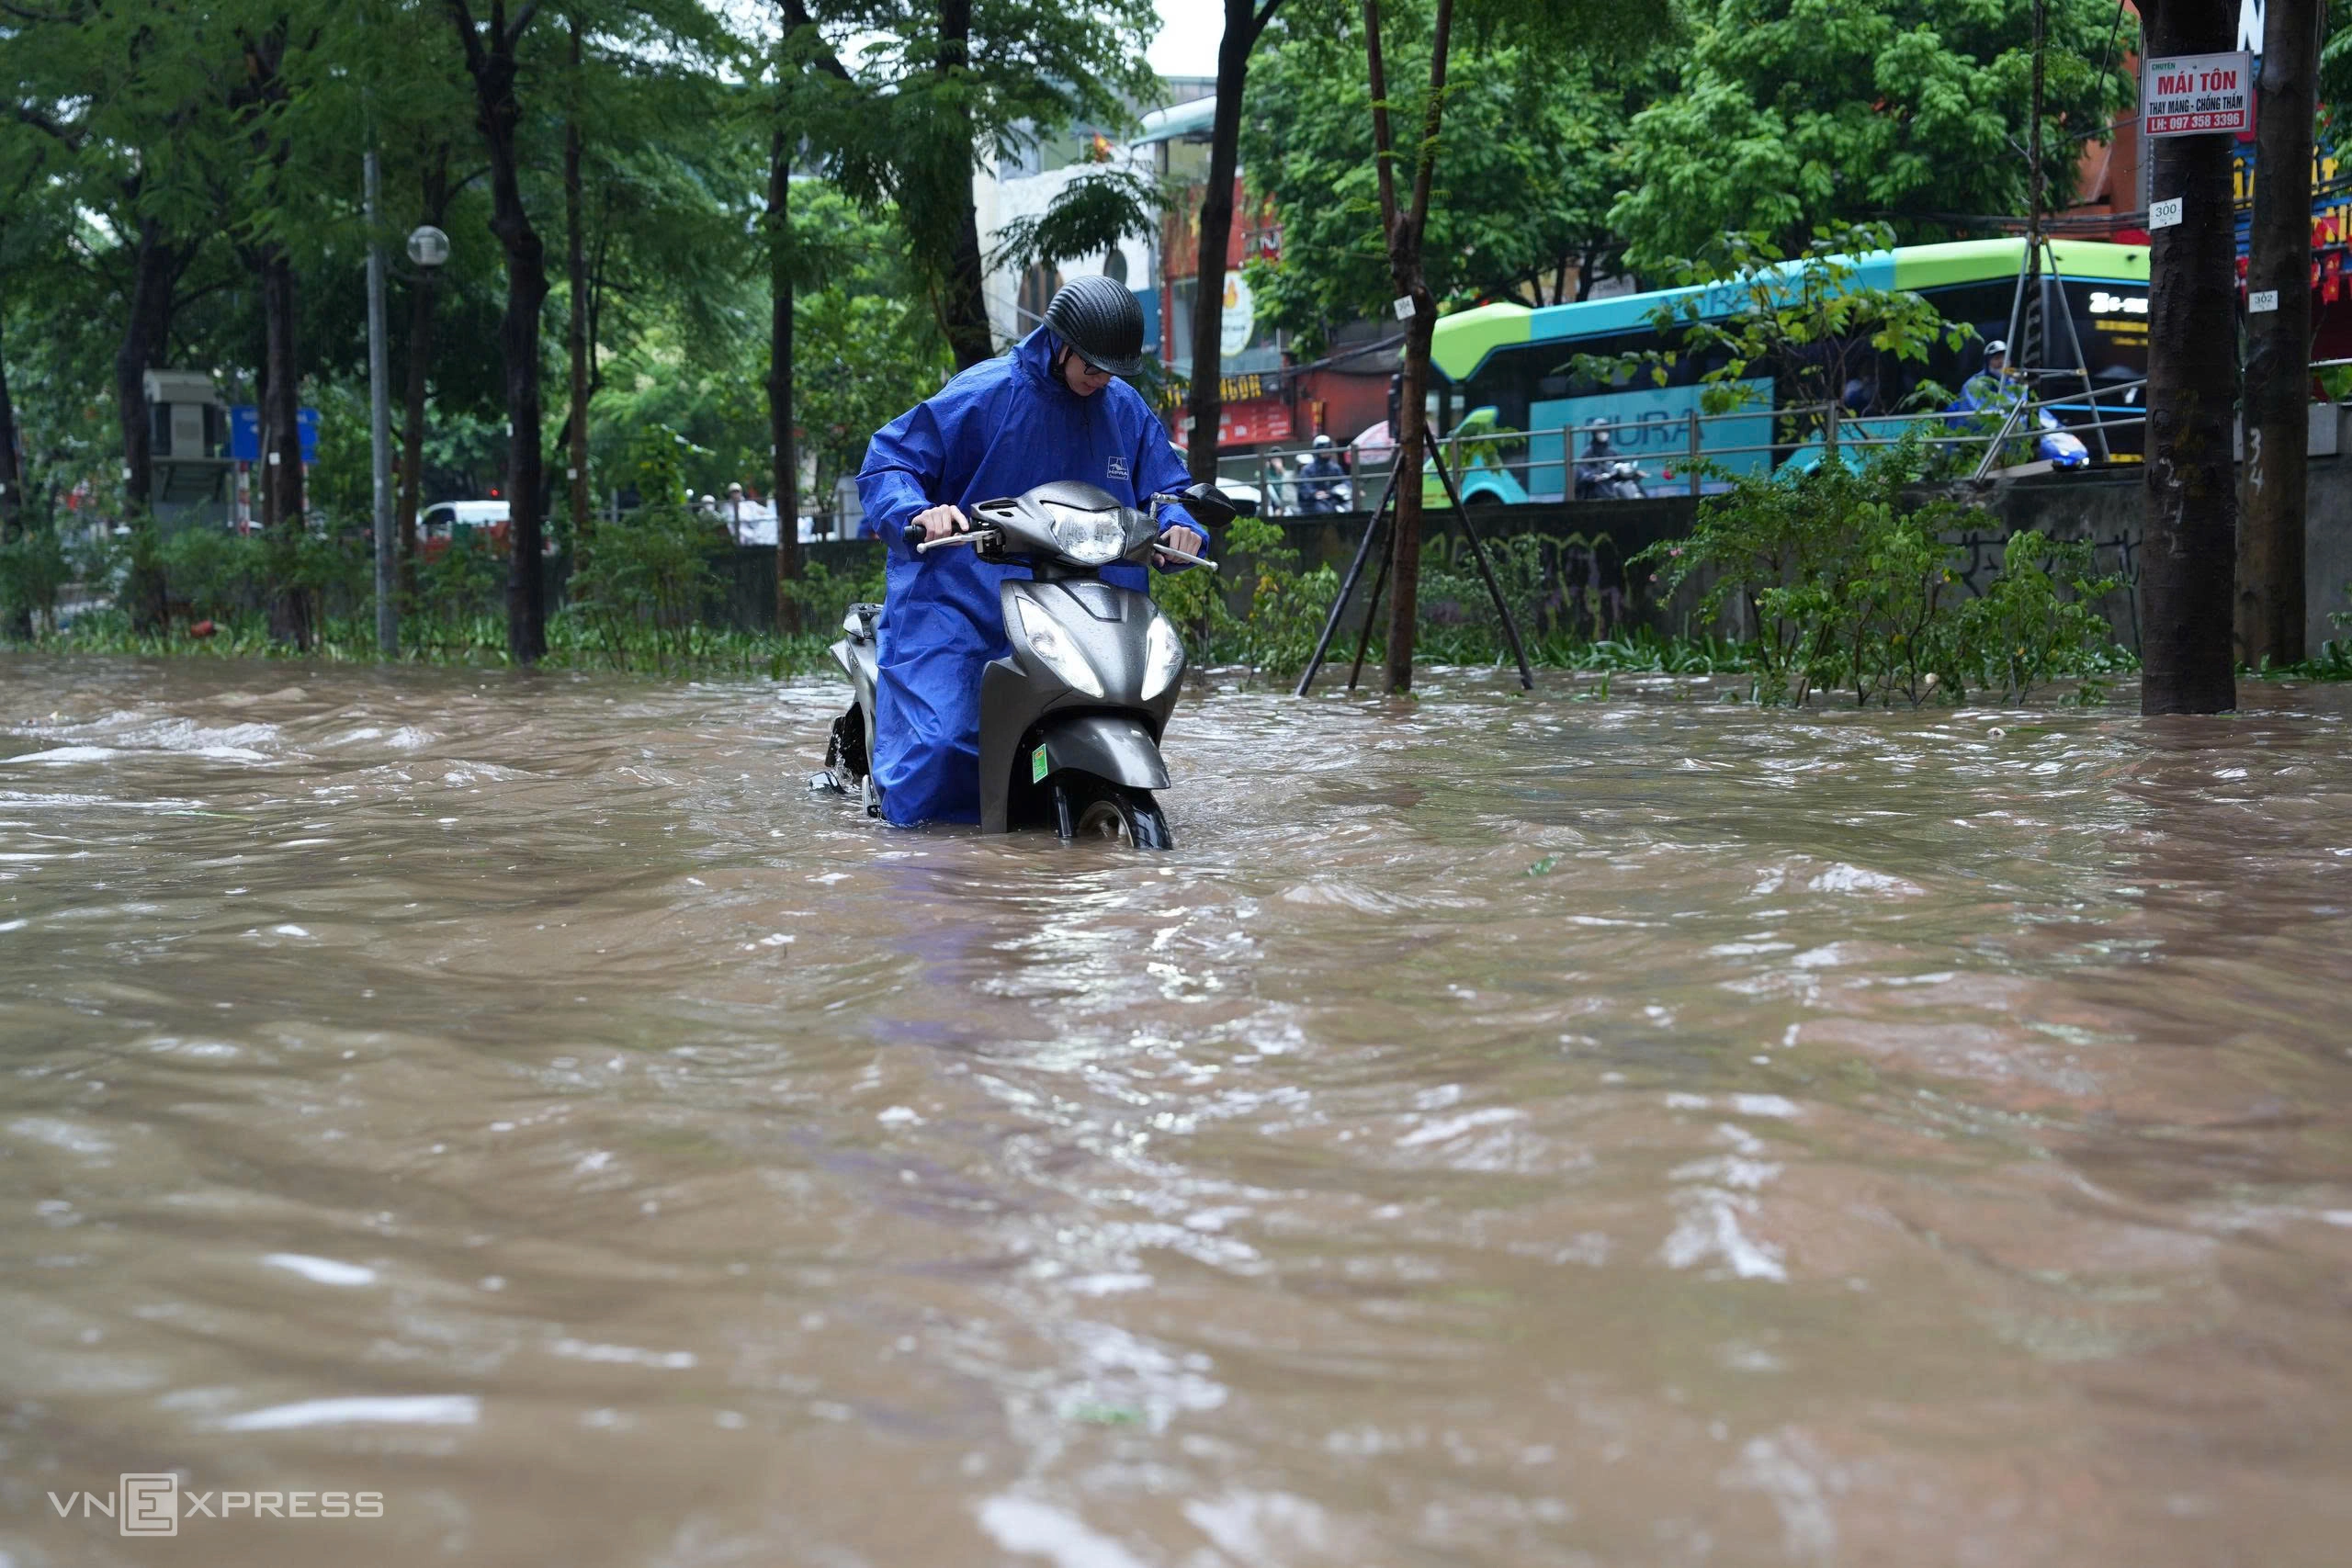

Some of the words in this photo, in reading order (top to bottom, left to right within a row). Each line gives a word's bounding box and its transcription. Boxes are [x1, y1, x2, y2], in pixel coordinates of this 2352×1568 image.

[2157, 70, 2193, 96] MÁI
[2200, 66, 2236, 93] TÔN
[2150, 101, 2166, 116] THAY
[2196, 93, 2221, 111] CHỐNG
[2151, 118, 2166, 131] LH:
[2170, 116, 2188, 129] 097
[2191, 114, 2211, 128] 358
[2214, 113, 2240, 127] 3396
[2155, 204, 2177, 217] 300
[2255, 294, 2273, 304] 302
